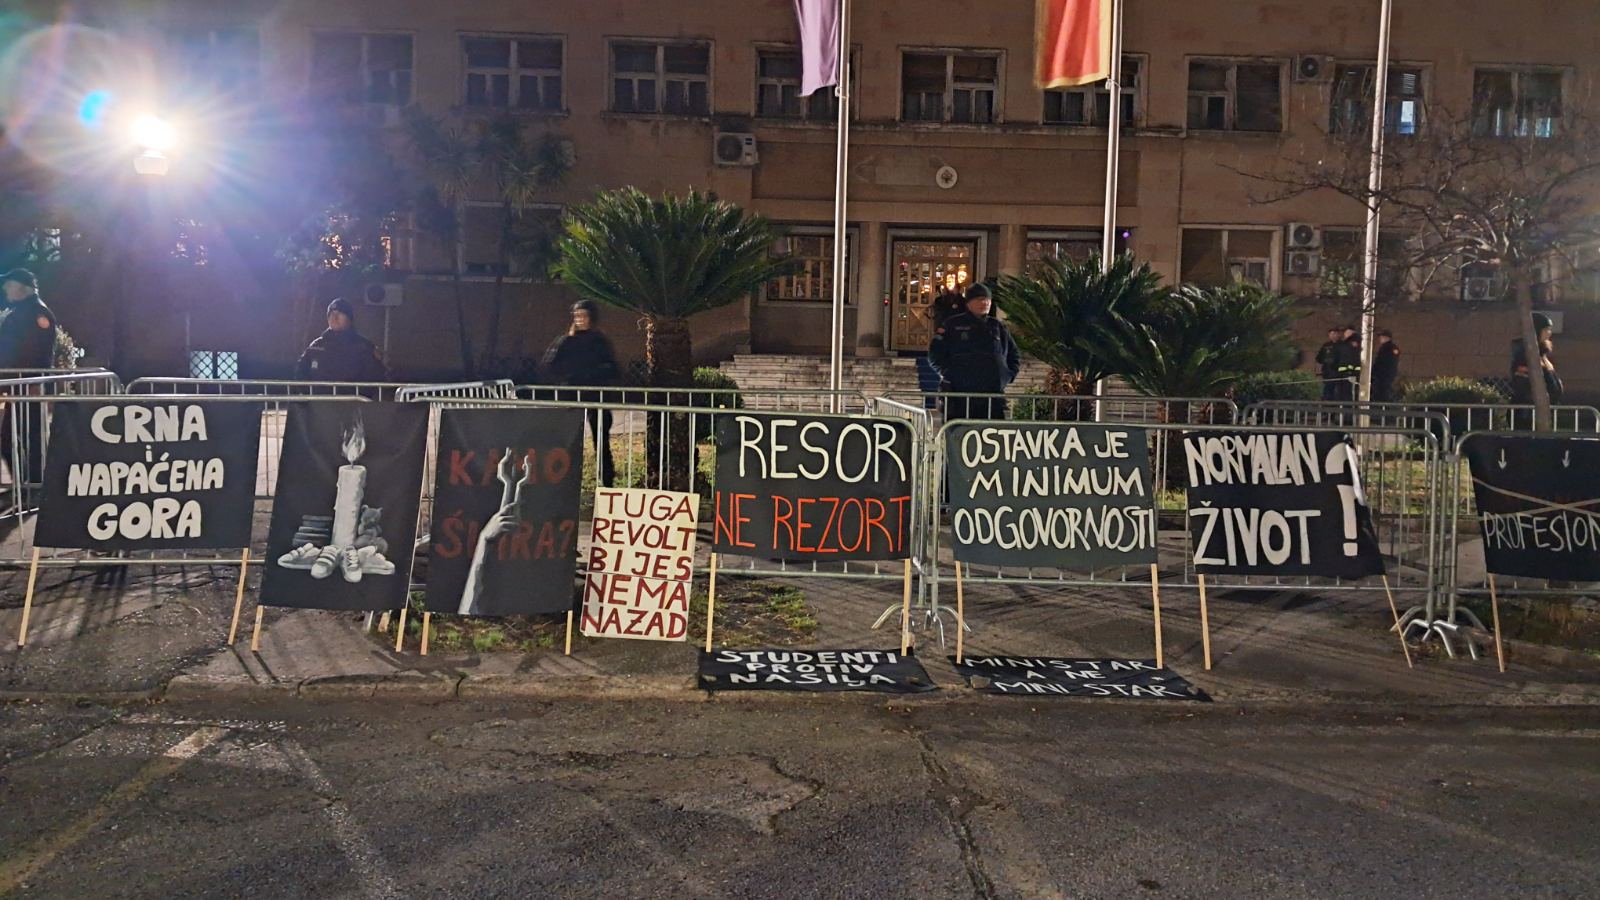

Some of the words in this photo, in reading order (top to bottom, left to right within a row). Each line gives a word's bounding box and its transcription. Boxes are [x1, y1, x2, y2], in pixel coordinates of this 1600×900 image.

[91, 405, 208, 443] CRNA
[145, 444, 153, 462] i
[735, 416, 906, 483] RESOR
[961, 427, 1086, 468] OSTAVKA
[1093, 430, 1129, 458] JE
[1184, 433, 1321, 487] NORMALAN
[67, 452, 224, 496] NAPAĆENA
[969, 465, 1145, 499] MINIMUM
[87, 498, 202, 540] GORA
[600, 492, 695, 523] TUGA
[714, 490, 757, 548] NE
[771, 495, 911, 553] REZORT
[591, 517, 696, 551] REVOLT
[954, 504, 1156, 552] ODGOVORNOSTI
[1189, 500, 1322, 566] ŽIVOT
[588, 546, 692, 581] BIJES
[584, 573, 688, 612] NEMA
[580, 604, 688, 638] NAZAD
[716, 650, 898, 664] STUDENTI
[745, 662, 875, 674] PROTIV
[964, 657, 1158, 671] MINISTAR
[994, 681, 1071, 695] MINI
[1083, 682, 1188, 697] STAR
[1027, 669, 1046, 679] A
[1066, 669, 1107, 681] NE
